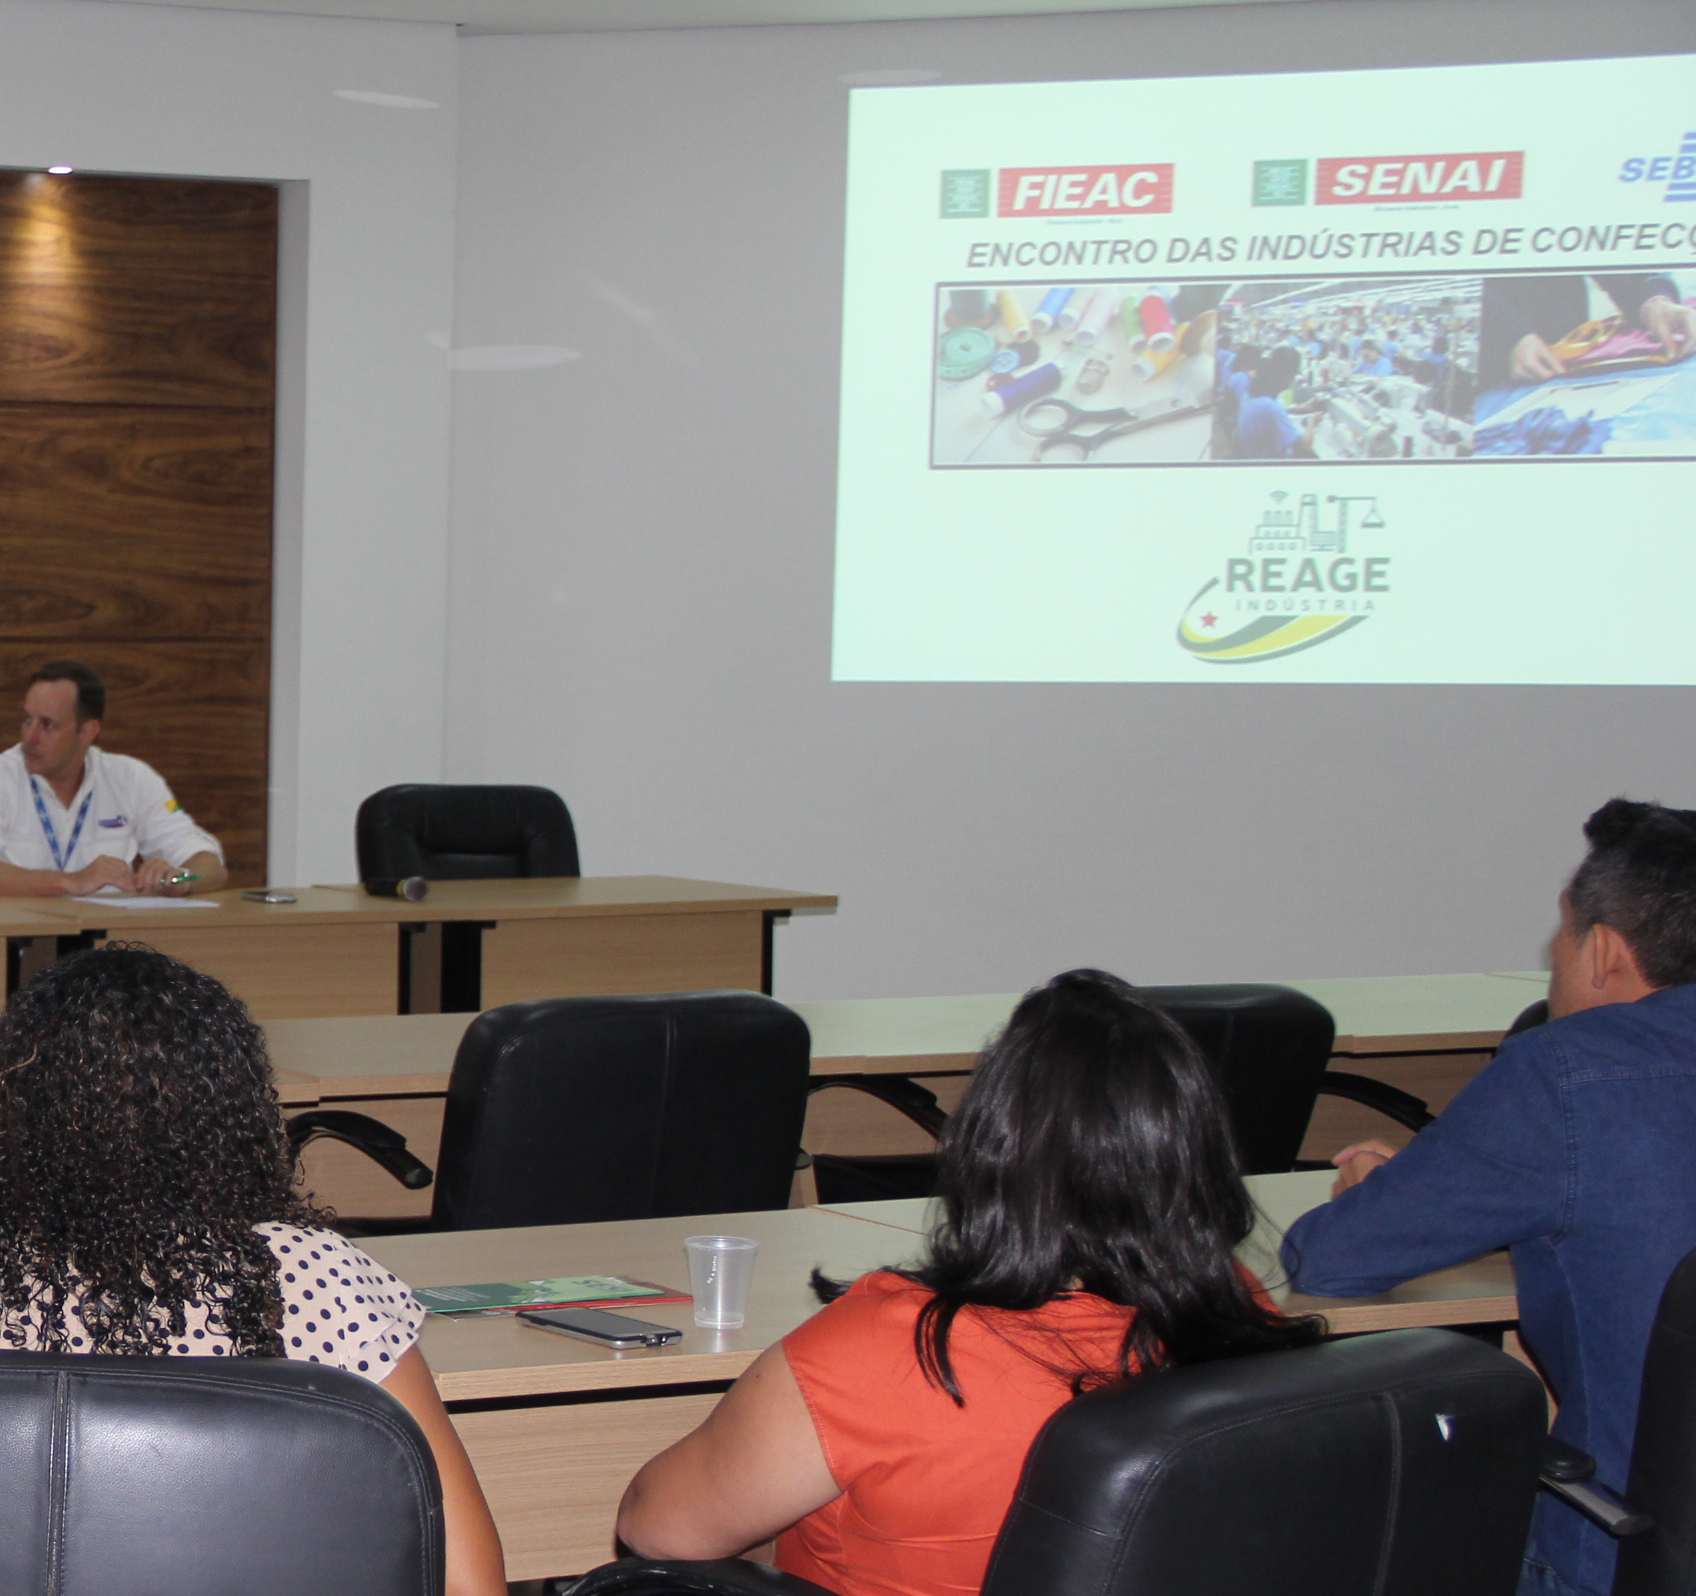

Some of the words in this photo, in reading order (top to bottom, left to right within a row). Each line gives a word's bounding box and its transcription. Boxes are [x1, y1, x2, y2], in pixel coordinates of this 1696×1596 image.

[1012, 171, 1159, 211] FIEAC
[1331, 158, 1507, 197] SENAI
[965, 238, 1158, 268] ENCONTRO
[1165, 236, 1237, 263] DAS
[1246, 228, 1461, 262] INDÚSTRIAS
[1472, 227, 1525, 256] DE
[1225, 557, 1391, 593] REAGE
